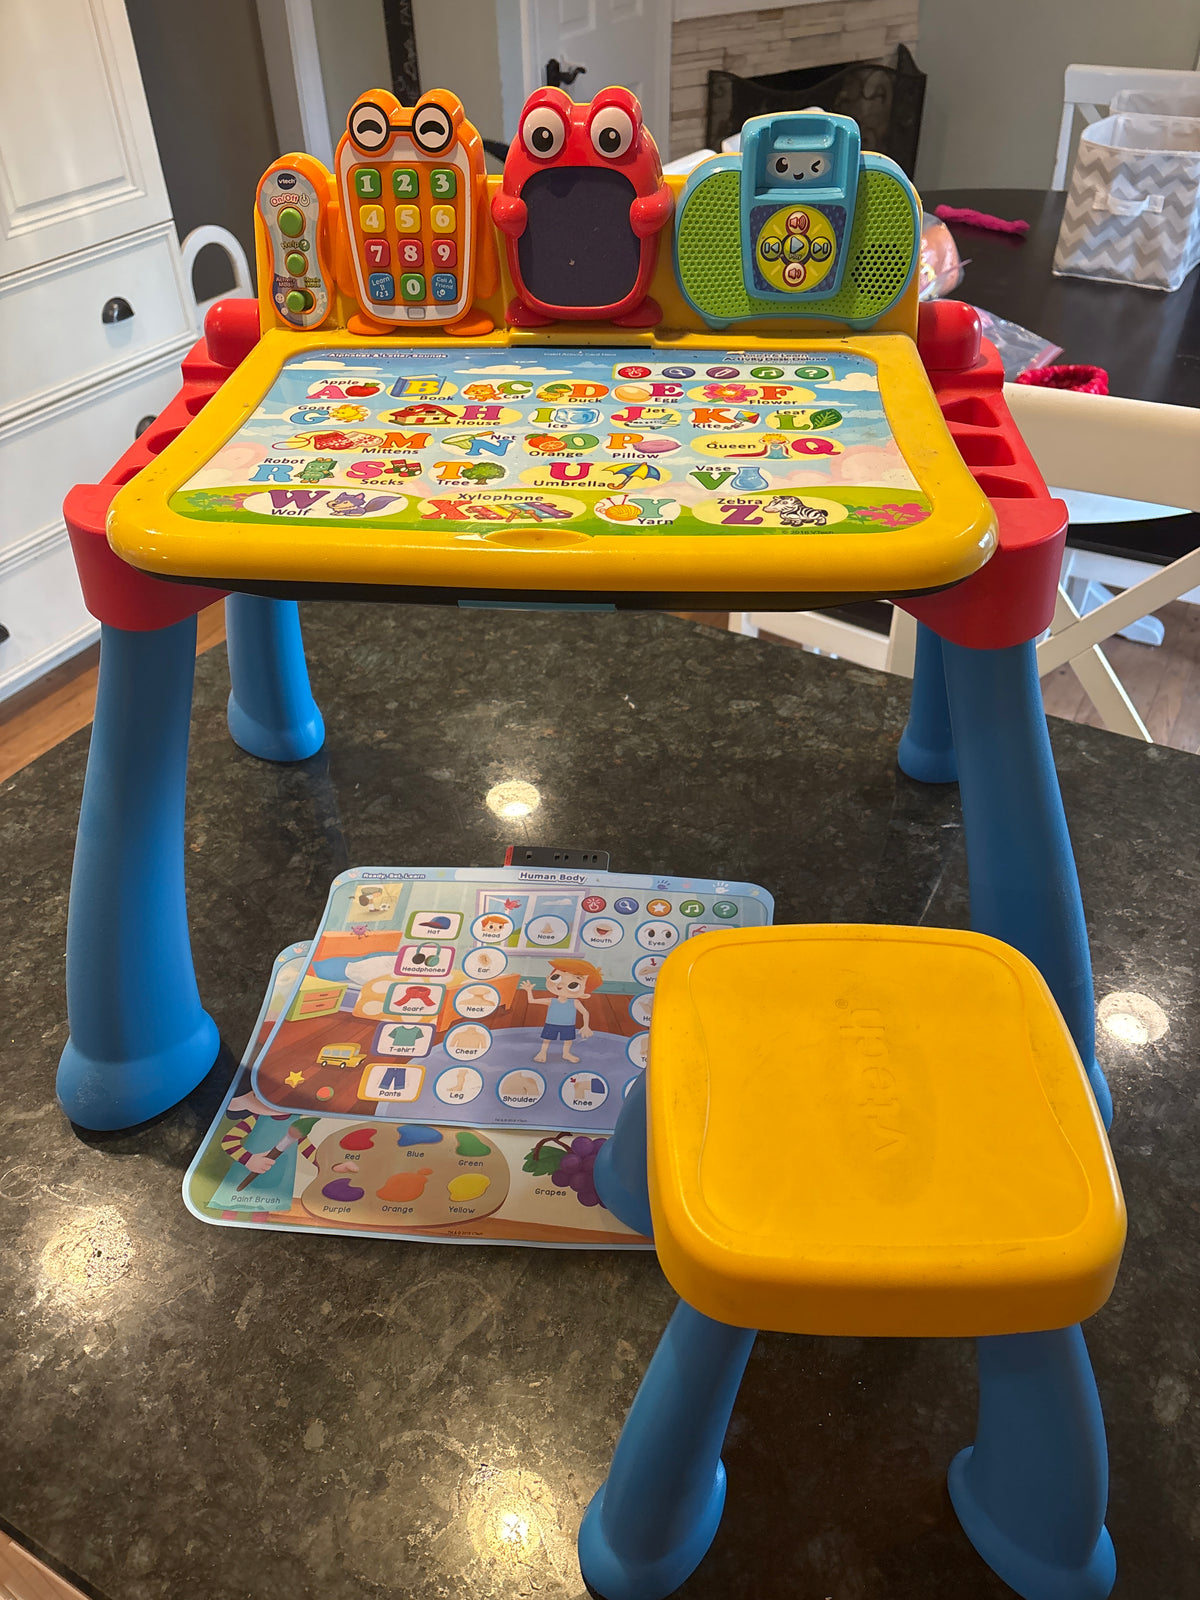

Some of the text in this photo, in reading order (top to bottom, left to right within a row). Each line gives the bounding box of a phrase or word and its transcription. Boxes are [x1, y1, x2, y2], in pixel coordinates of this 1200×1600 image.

[361, 176, 374, 192] 1
[397, 175, 412, 192] 2
[435, 175, 449, 192] 3
[271, 193, 299, 206] On/Off
[366, 210, 379, 228] 4
[400, 210, 413, 228] 5
[436, 210, 449, 228] 6
[371, 246, 382, 262] 7
[404, 245, 418, 262] 8
[437, 245, 450, 262] 9
[371, 276, 390, 286] Learn
[406, 279, 420, 295] 0
[435, 282, 453, 290] Friend
[320, 379, 359, 388] Apple
[404, 381, 440, 395] B
[497, 380, 534, 394] C
[649, 383, 684, 398] E
[305, 385, 348, 399] A
[568, 383, 609, 399] D
[761, 386, 794, 400] F
[290, 409, 331, 425] G
[459, 405, 504, 421] H
[534, 407, 556, 423] I
[610, 406, 647, 421] J
[692, 408, 732, 424] K
[774, 415, 811, 431] L
[379, 432, 432, 449] M
[465, 439, 514, 456] N
[607, 433, 644, 450] P
[706, 442, 756, 451] Queen
[791, 437, 842, 456] Q
[264, 457, 305, 465] Robot
[528, 450, 583, 459] Orange
[249, 464, 293, 482] R
[346, 461, 386, 479] S
[434, 461, 474, 479] T
[549, 462, 594, 480] U
[695, 464, 731, 472] Vase
[360, 478, 404, 486] Socks
[533, 480, 606, 488] Umbrella
[690, 471, 737, 491] V
[267, 489, 330, 510] W
[458, 492, 544, 503] Xylophone
[717, 497, 763, 506] Zebra
[271, 508, 311, 517] Wolf
[421, 500, 472, 520] X
[628, 498, 676, 518] Y
[720, 505, 763, 525] Z
[637, 517, 674, 526] Yarn
[362, 872, 387, 880] Ready,
[520, 872, 586, 884] Human Body
[401, 966, 446, 974] Headphones
[389, 1046, 416, 1054] T-shirt
[455, 1048, 478, 1056] Chest
[379, 1089, 401, 1098] Pants
[449, 1091, 464, 1101] Leg
[502, 1095, 538, 1104] Shoulder
[573, 1099, 592, 1107] Knee
[344, 1153, 361, 1161] Red
[406, 1150, 425, 1158] Blue
[458, 1159, 484, 1167] Green
[231, 1195, 281, 1204] Paint Brush
[535, 1188, 567, 1197] Grapes
[322, 1205, 351, 1214] Purple
[381, 1205, 414, 1214] Orange
[449, 1206, 476, 1214] Yellow
